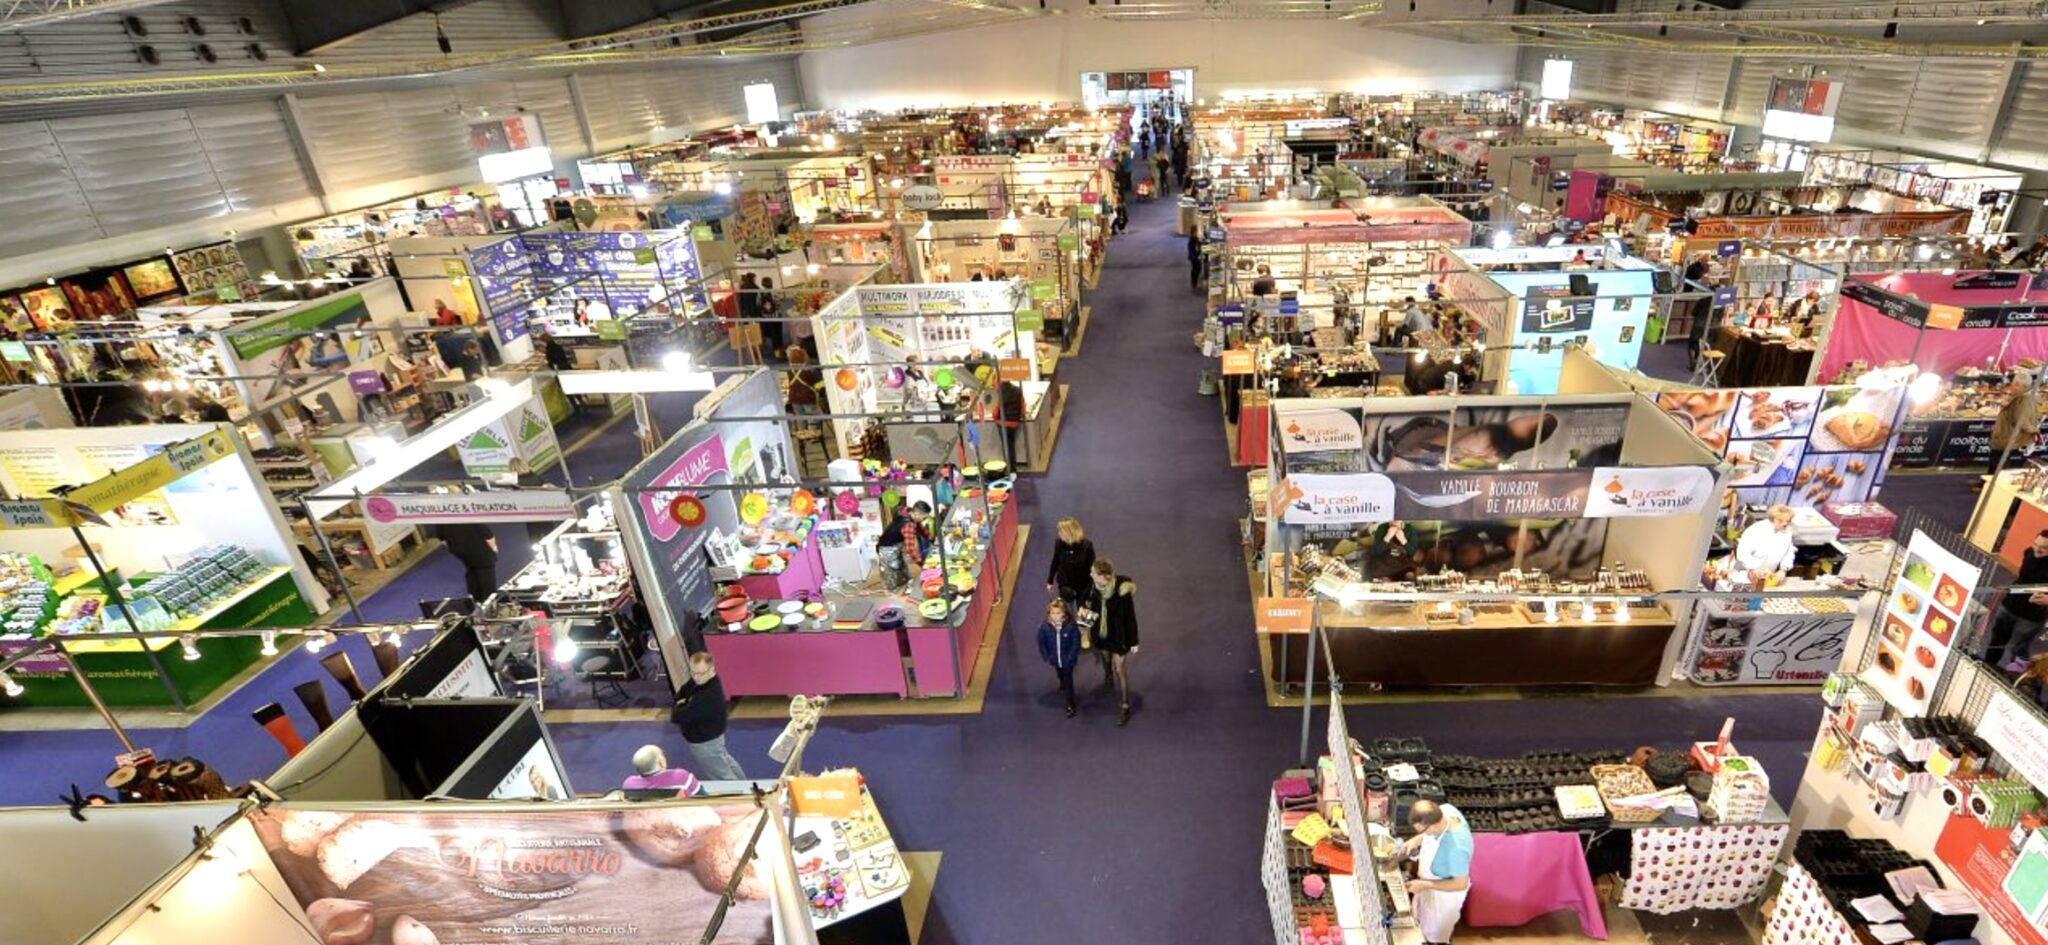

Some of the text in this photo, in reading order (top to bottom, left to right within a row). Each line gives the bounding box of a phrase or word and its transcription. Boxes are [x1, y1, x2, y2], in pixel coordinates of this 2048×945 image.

[1322, 433, 1355, 444] vanille
[169, 443, 202, 463] Aromas
[1440, 478, 1539, 497] VANILLE BOURBON
[1314, 494, 1359, 505] la case
[1486, 496, 1578, 513] DE MADAGASCAR
[0, 502, 41, 516] Aromas
[401, 503, 460, 515] MAQUILLAGE
[462, 503, 470, 513] &
[471, 501, 517, 513] ÉPILATION
[1323, 502, 1381, 515] à vanille
[13, 511, 46, 526] Spain
[430, 657, 475, 699] XCLUSIVITÉ
[432, 835, 622, 883] Navarro
